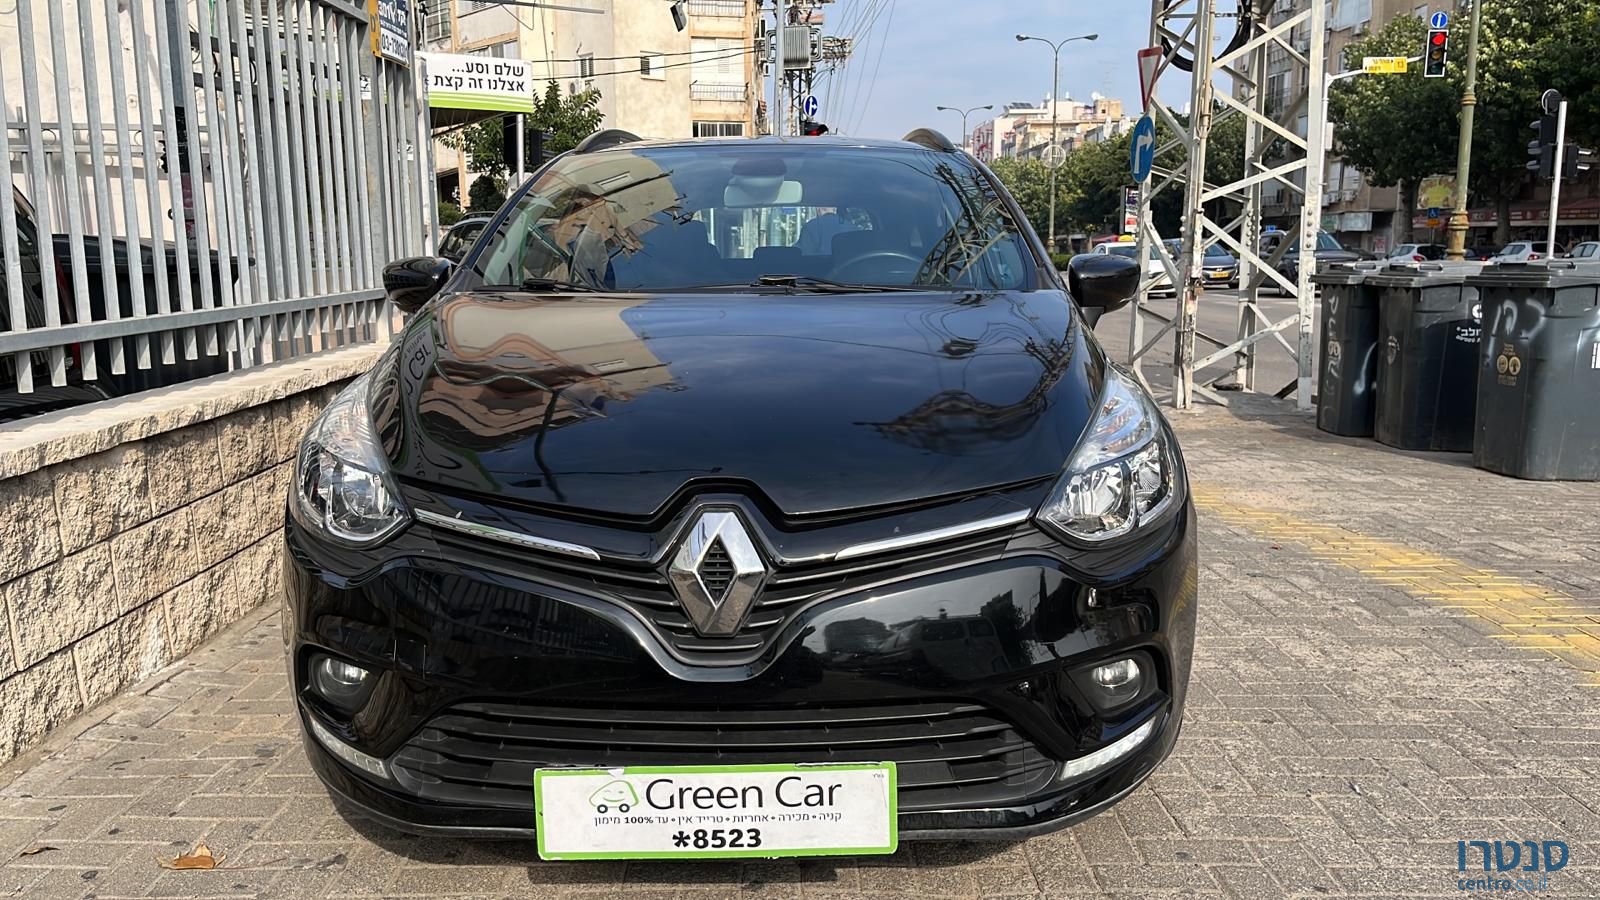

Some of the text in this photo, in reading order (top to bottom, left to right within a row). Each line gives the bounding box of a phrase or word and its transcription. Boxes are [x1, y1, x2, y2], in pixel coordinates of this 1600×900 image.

[451, 62, 524, 77] שלם וסע...
[434, 75, 463, 91] קצת
[468, 77, 483, 89] זה
[489, 77, 525, 92] אצלנו
[645, 776, 843, 810] Green Car
[593, 812, 842, 828] קניה מכירה אחריות טרייד אין עד 100% מימון
